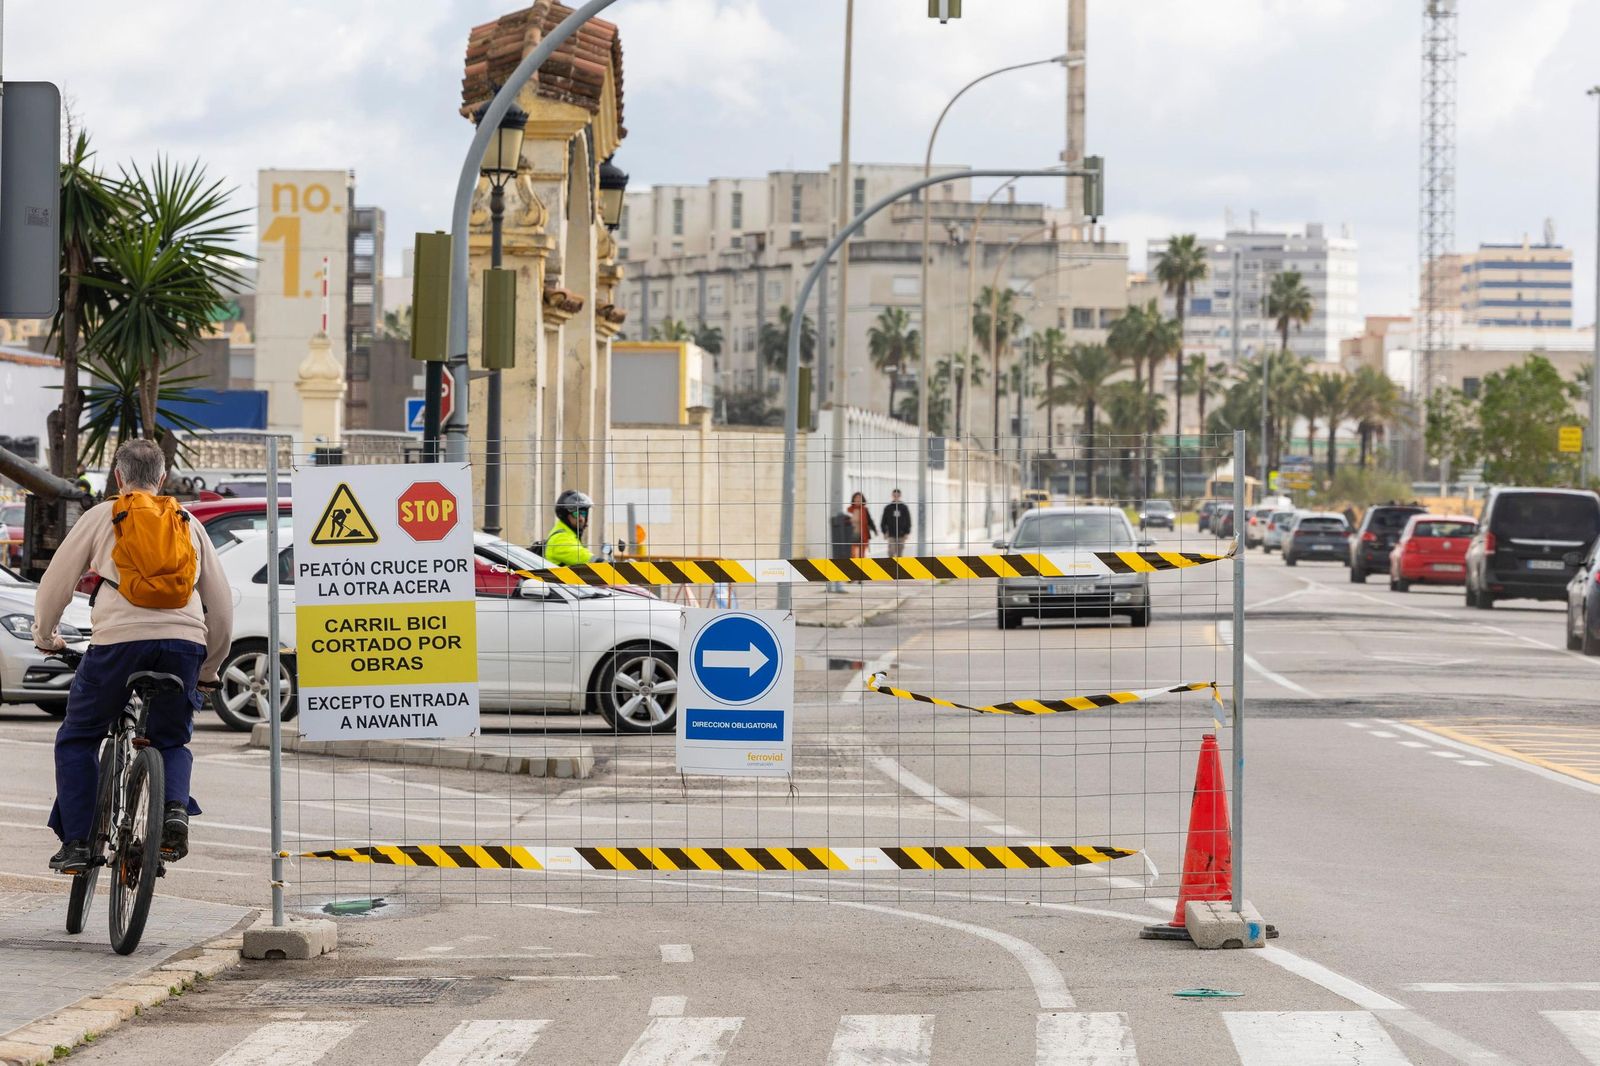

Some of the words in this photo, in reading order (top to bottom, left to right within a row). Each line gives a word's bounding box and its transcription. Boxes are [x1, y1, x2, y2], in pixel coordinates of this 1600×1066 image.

[271, 181, 342, 214] no.
[400, 499, 455, 523] STOP
[299, 558, 365, 578] PEATÓN
[371, 560, 428, 575] CRUCE
[433, 558, 468, 573] POR
[318, 583, 340, 597] LA
[343, 581, 390, 596] OTRA
[393, 579, 451, 595] ACERA
[324, 618, 402, 633] CARRIL
[406, 615, 447, 631] BICI
[311, 636, 412, 654] CORTADO
[418, 635, 463, 651] POR
[350, 656, 424, 673] OBRAS
[307, 694, 385, 711] EXCEPTO
[390, 692, 470, 709] ENTRADA
[340, 715, 353, 730] A
[356, 712, 439, 729] NAVANTIA
[691, 720, 731, 729] DIRECCION
[731, 721, 778, 730] OBLIGATORIA
[747, 751, 784, 761] ferrovial
